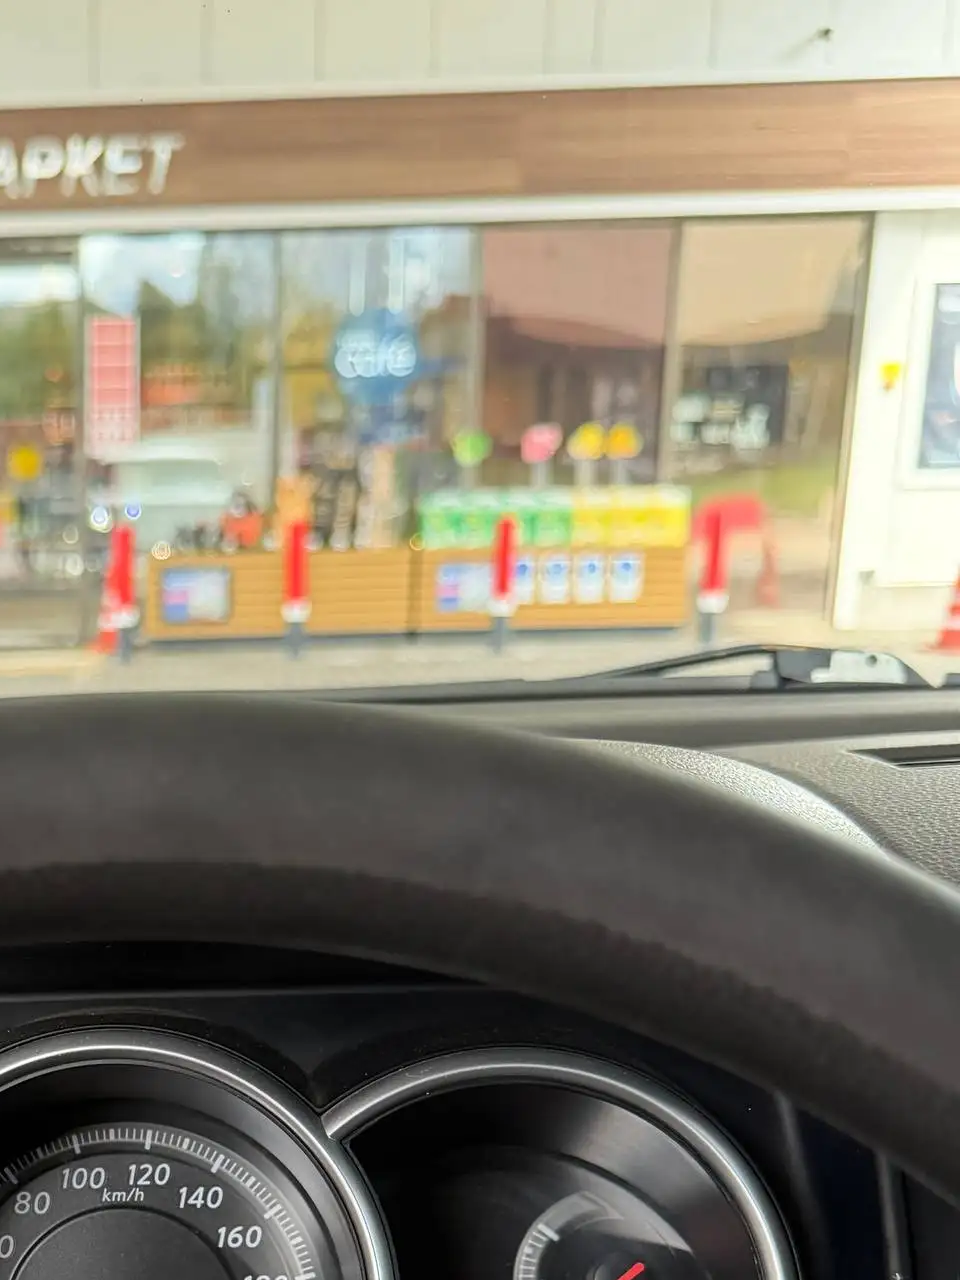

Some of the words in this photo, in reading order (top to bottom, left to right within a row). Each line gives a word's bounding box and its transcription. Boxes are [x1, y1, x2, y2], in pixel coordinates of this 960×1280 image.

[61, 1167, 106, 1190] 100
[127, 1163, 171, 1186] 120
[13, 1191, 51, 1215] 80
[101, 1187, 145, 1203] km/h
[177, 1186, 223, 1209] 140
[216, 1226, 262, 1248] 160
